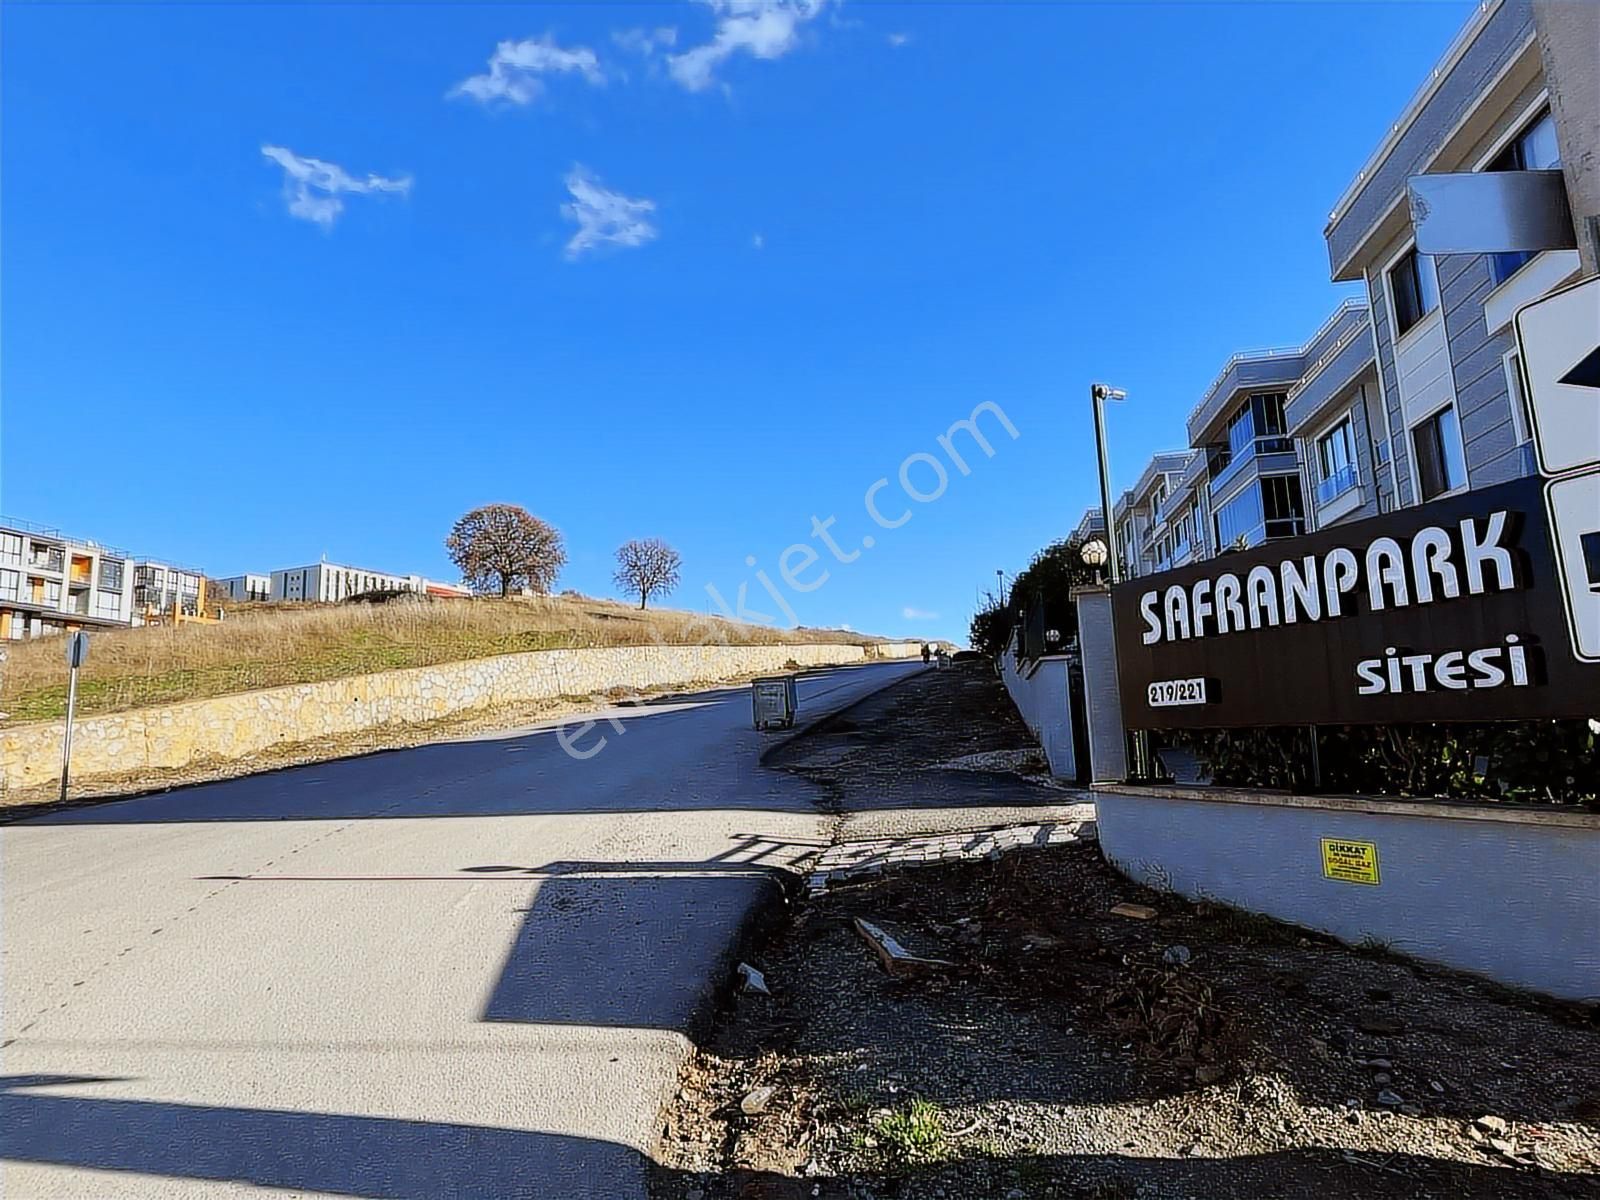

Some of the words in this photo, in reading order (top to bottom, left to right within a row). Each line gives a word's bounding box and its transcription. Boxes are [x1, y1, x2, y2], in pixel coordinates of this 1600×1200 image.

[1140, 510, 1515, 645] SAFRANPARK
[1150, 682, 1203, 703] 219/221
[1356, 634, 1529, 695] SİTESİ
